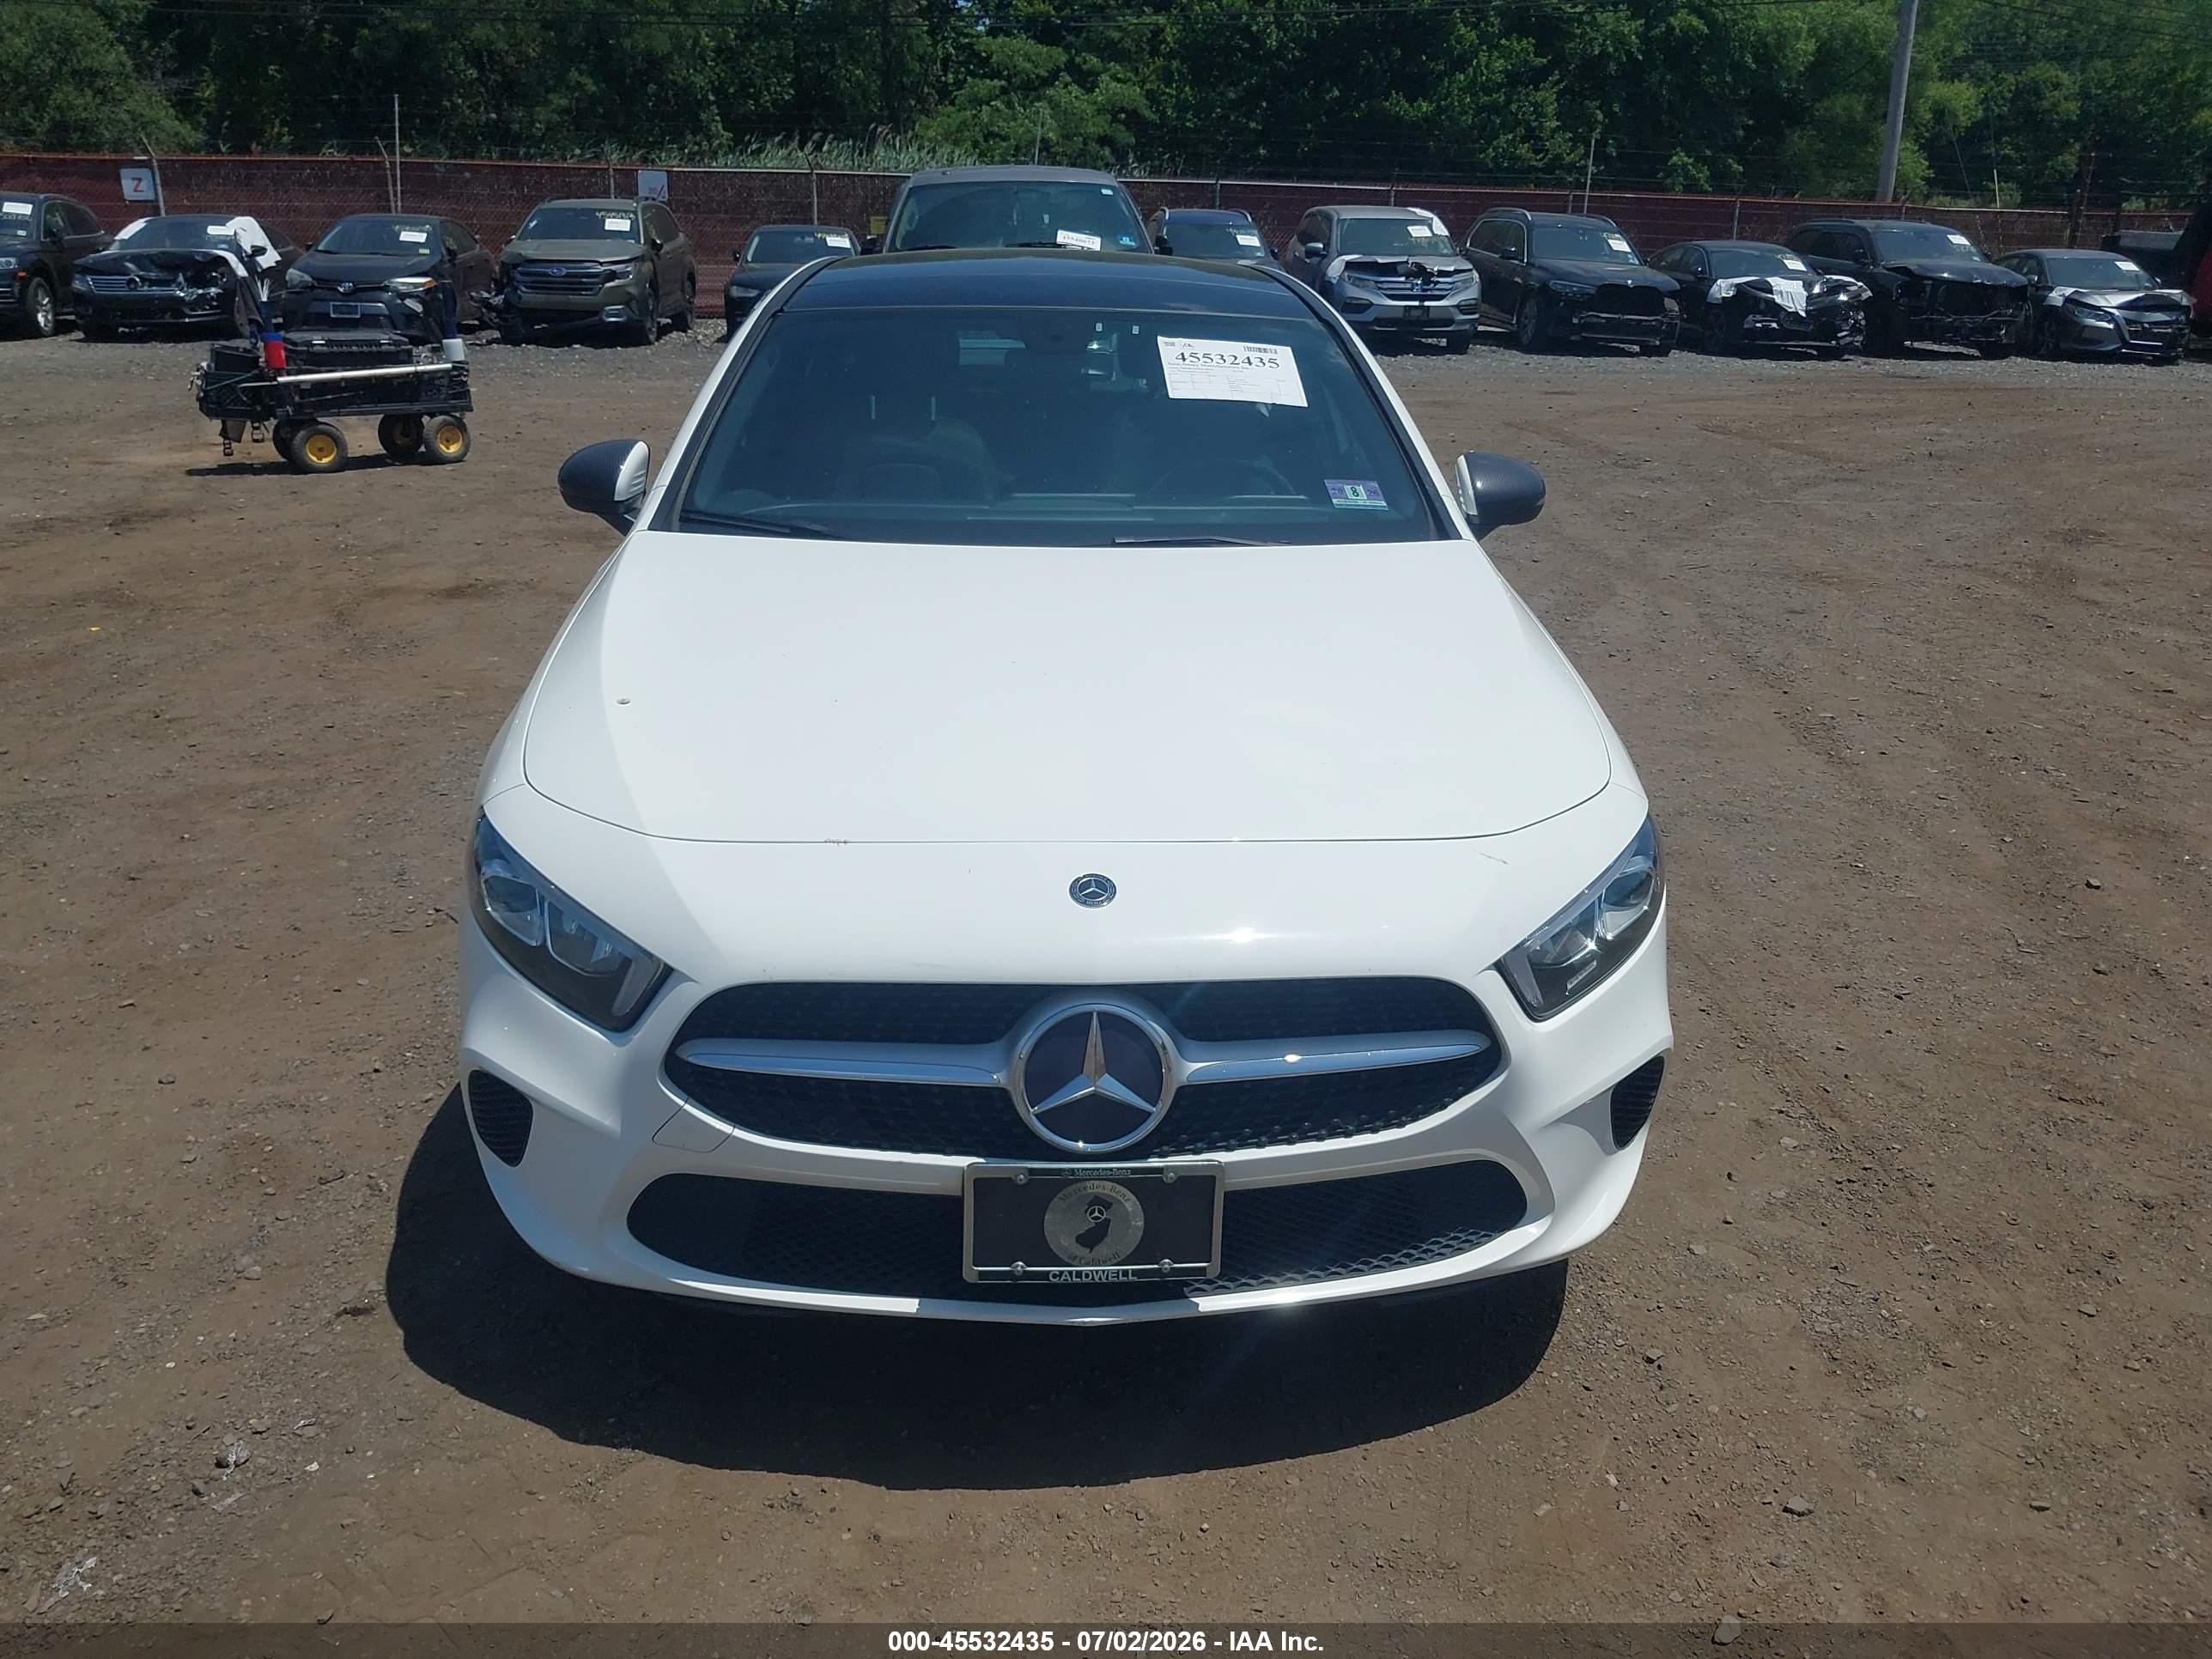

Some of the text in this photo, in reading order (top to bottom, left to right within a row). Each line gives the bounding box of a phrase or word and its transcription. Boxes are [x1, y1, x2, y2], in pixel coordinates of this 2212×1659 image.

[131, 177, 144, 192] Z
[1175, 351, 1280, 369] 45532435
[1351, 486, 1359, 497] 8
[1073, 1168, 1132, 1176] Mercedes-Benz
[1048, 1270, 1138, 1281] CALDWELL
